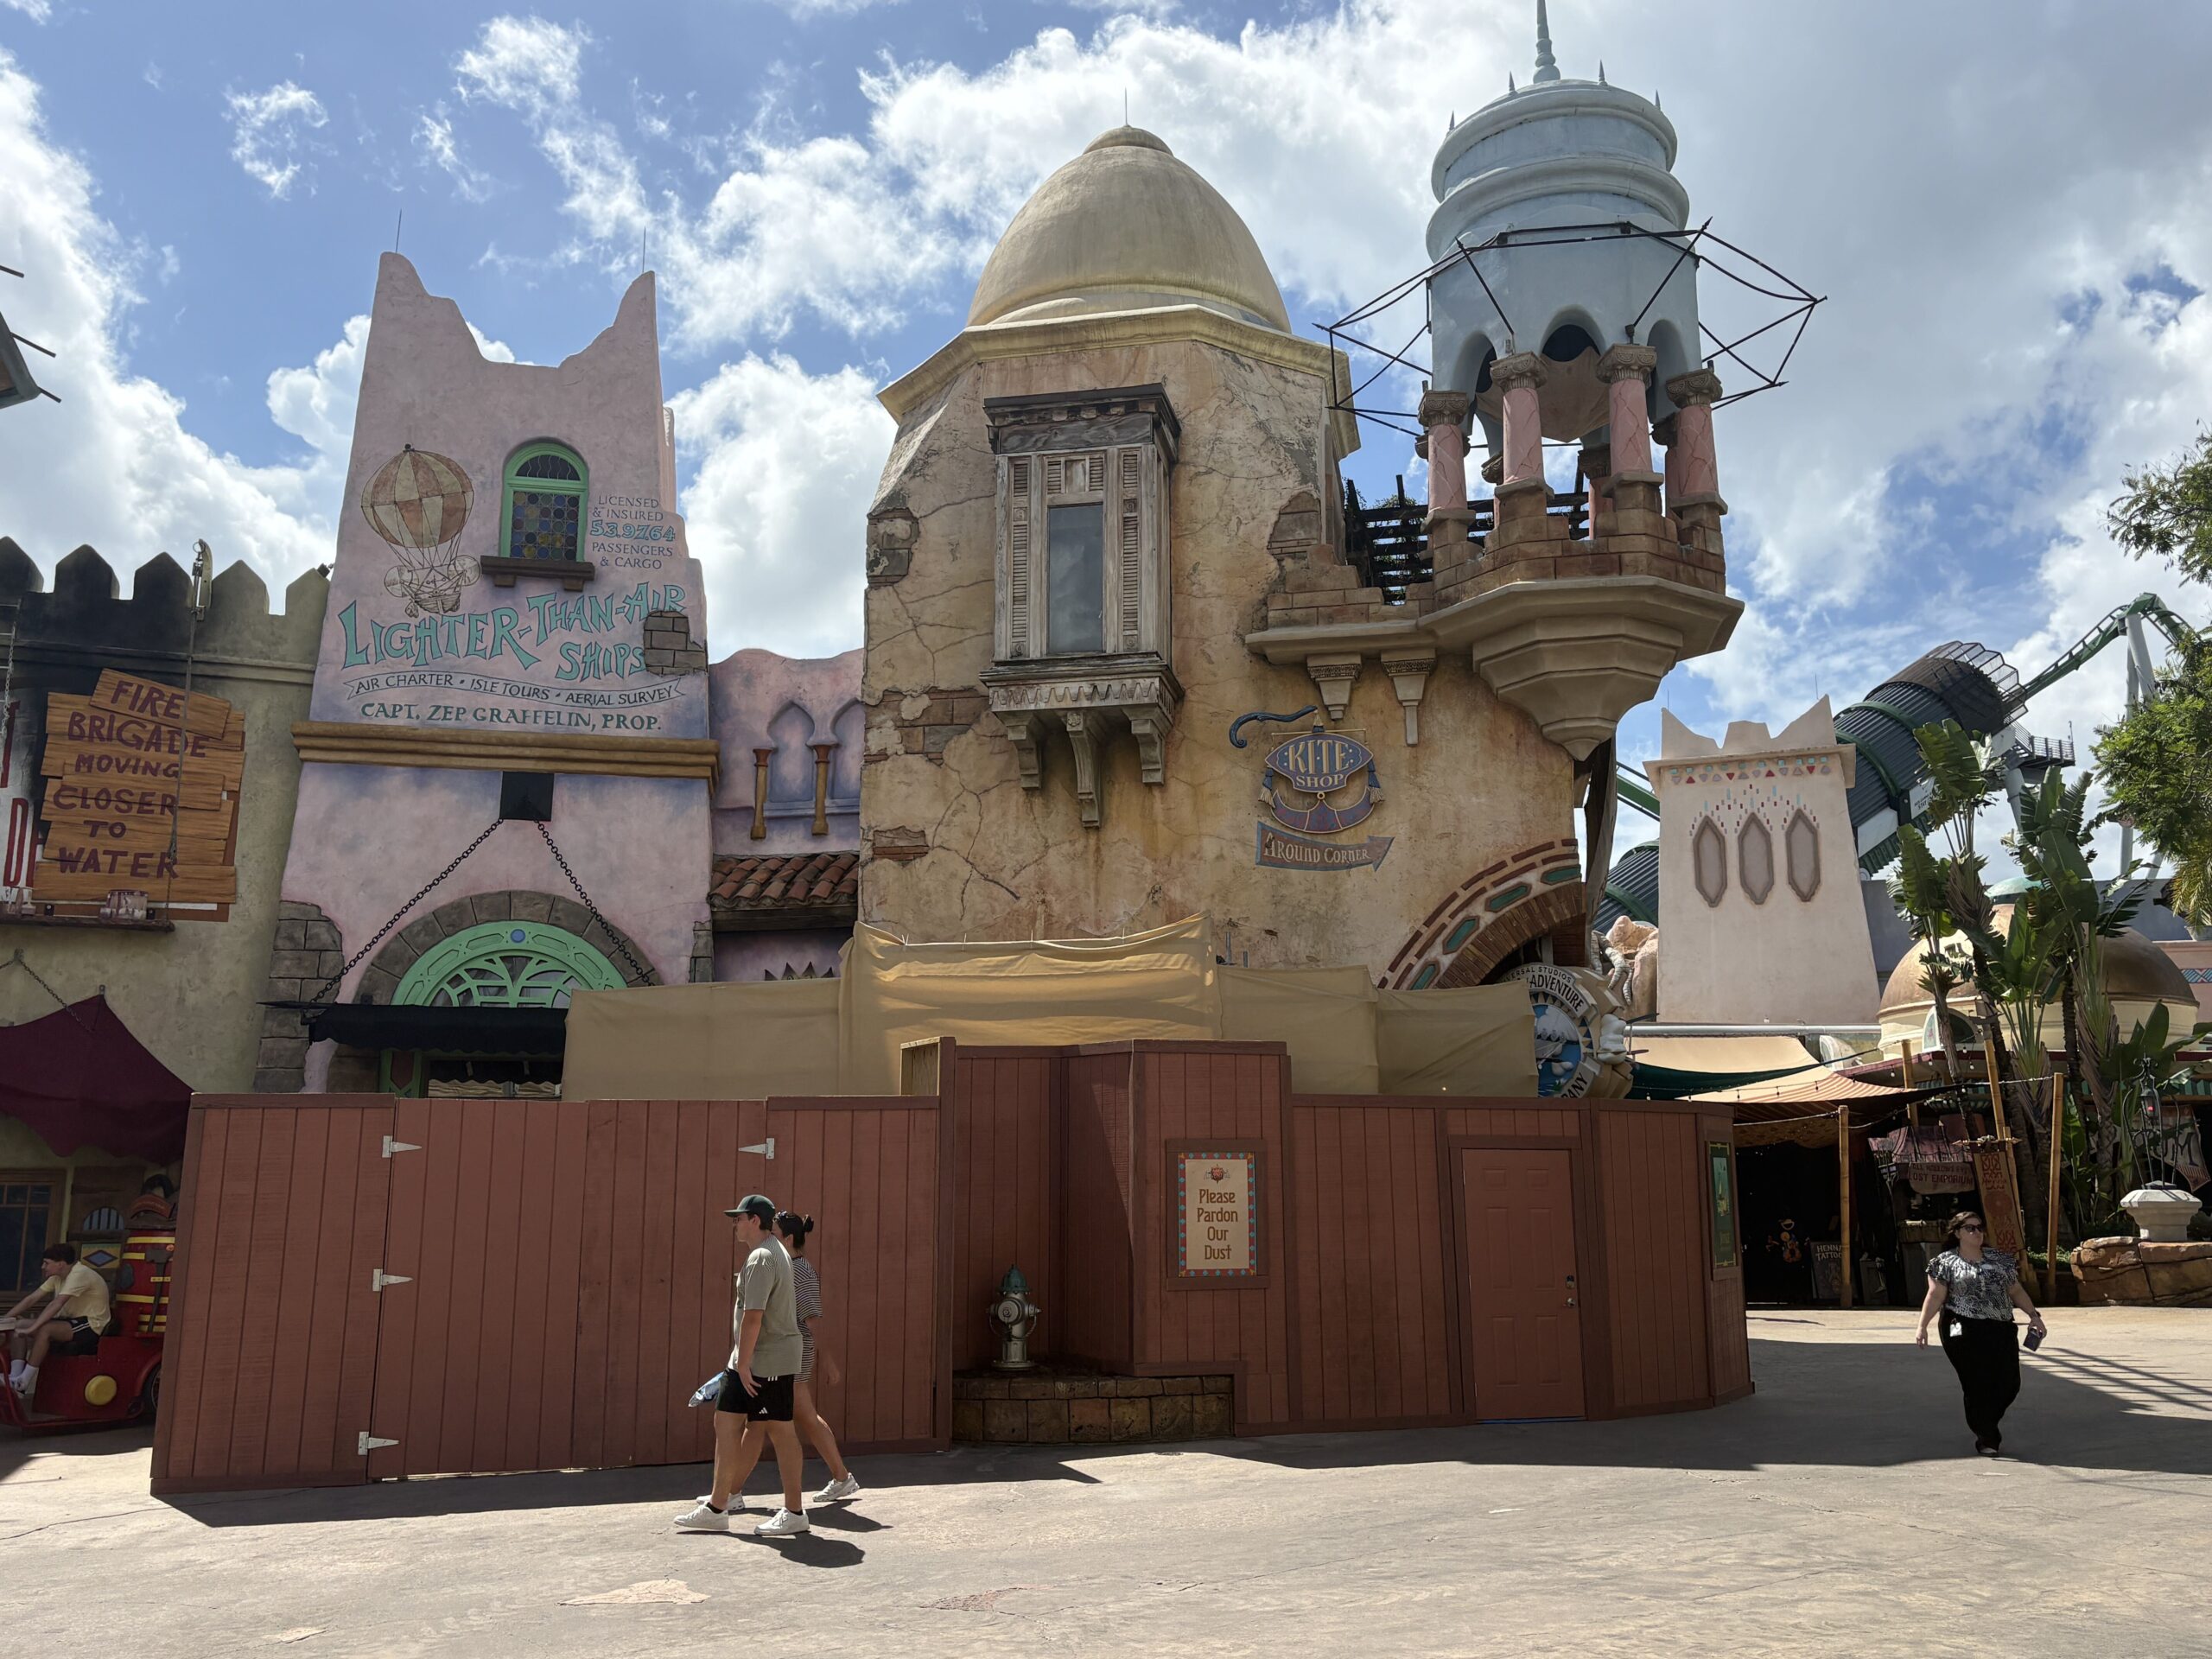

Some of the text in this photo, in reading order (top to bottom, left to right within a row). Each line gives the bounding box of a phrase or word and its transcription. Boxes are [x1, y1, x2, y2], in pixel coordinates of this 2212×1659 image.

[598, 495, 659, 509] LICENSED
[592, 507, 664, 522] & INSURED
[592, 542, 674, 557] PASSENGERS
[600, 556, 663, 570] & CARGO
[555, 641, 646, 683] SHIPS
[355, 673, 672, 706] AIR CHARTER ISLE TOURS AERIAL SURVEY
[111, 680, 185, 720] FIRE
[360, 702, 661, 732] CAPT. ZEP GRAFFELIN, PROP.
[67, 711, 210, 758] BRIGADE
[74, 753, 181, 778] MOVING
[1288, 740, 1351, 774] KITE
[1296, 774, 1344, 788] SHOP
[53, 785, 178, 816] CLOSER
[83, 820, 127, 838] TO
[1263, 831, 1370, 864] AROUND CORNER
[58, 847, 180, 879] WATER
[1538, 966, 1572, 983] STUDIOS
[1529, 974, 1585, 1013] ADVENTURE
[1931, 1173, 1974, 1186] EMPORIUM
[1199, 1188, 1236, 1204] Please
[1197, 1207, 1238, 1223] Pardon
[1207, 1226, 1229, 1241] Our
[1205, 1244, 1232, 1260] Dust
